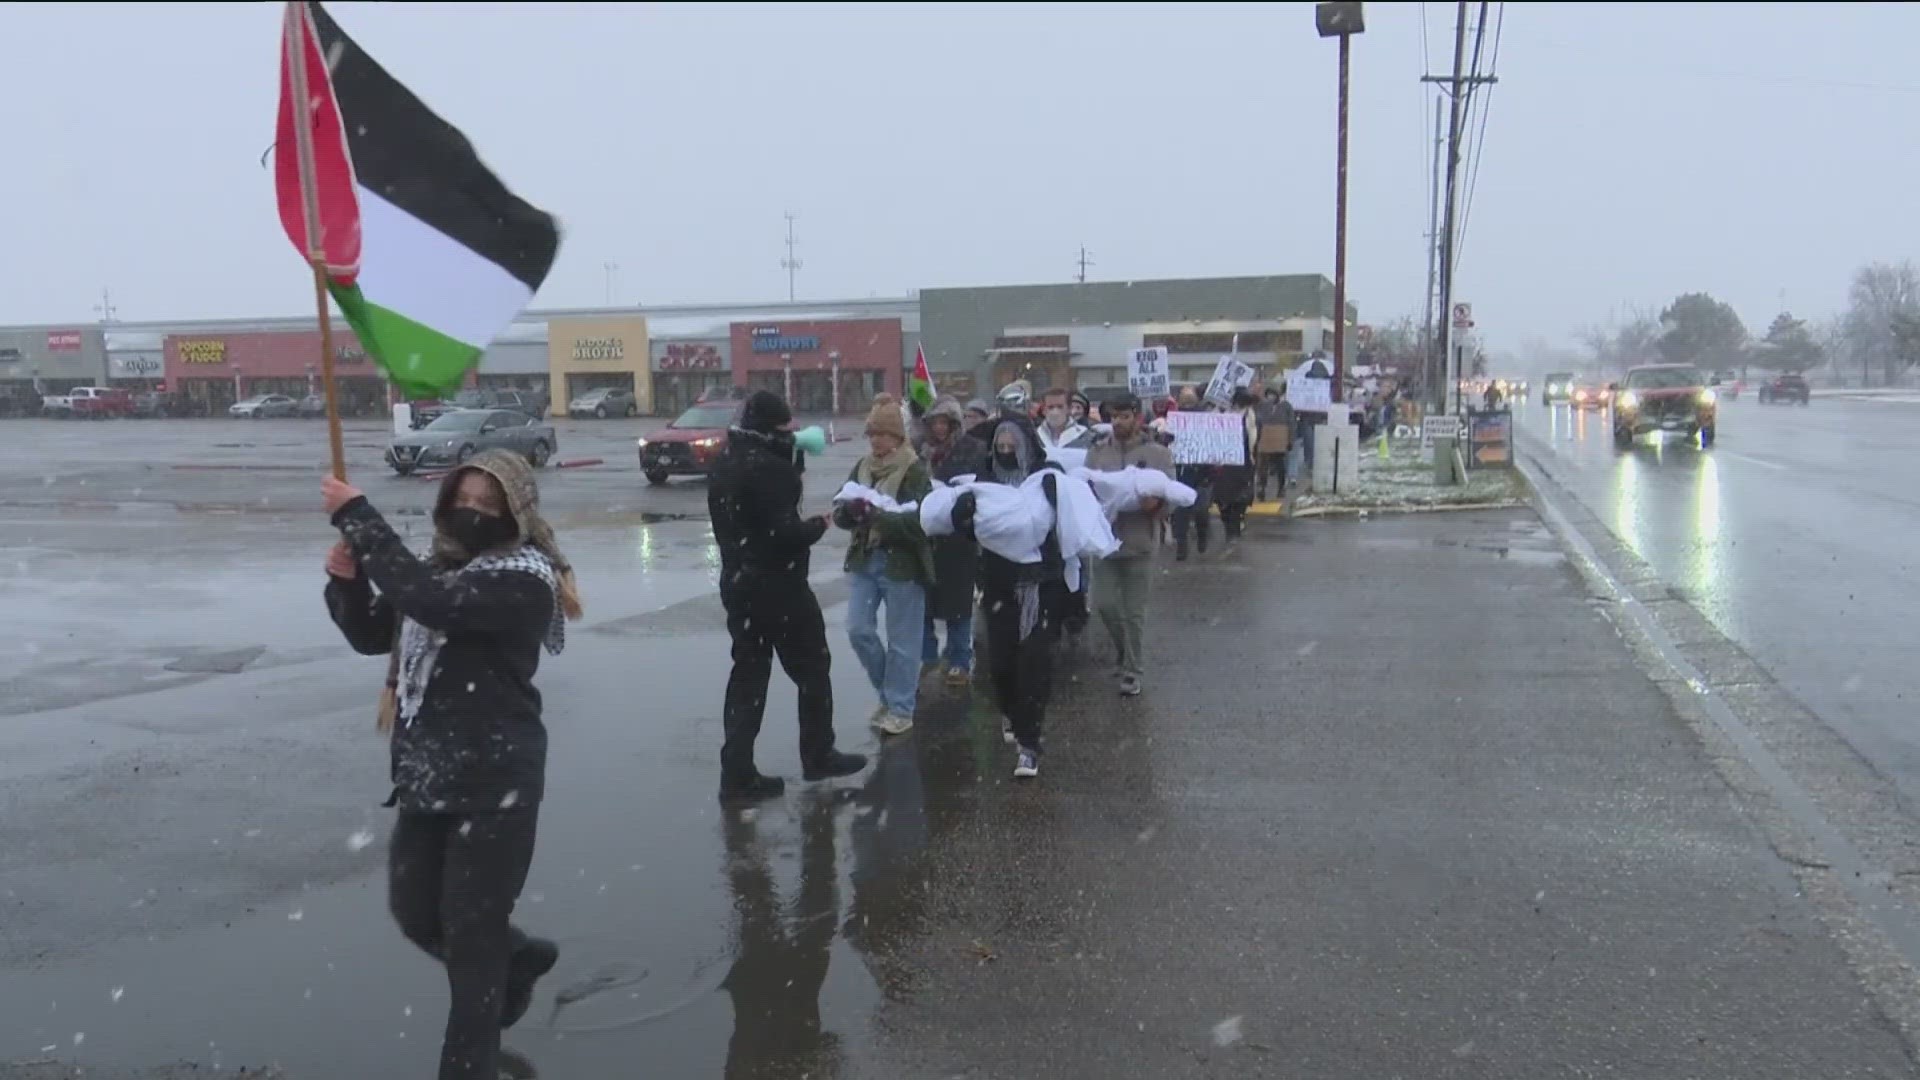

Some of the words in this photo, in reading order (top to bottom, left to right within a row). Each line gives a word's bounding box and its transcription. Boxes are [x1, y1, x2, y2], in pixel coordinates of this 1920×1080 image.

[178, 341, 225, 352] POPCORN
[191, 351, 223, 363] FUDGE
[1136, 350, 1157, 361] END
[1139, 361, 1157, 373] ALL
